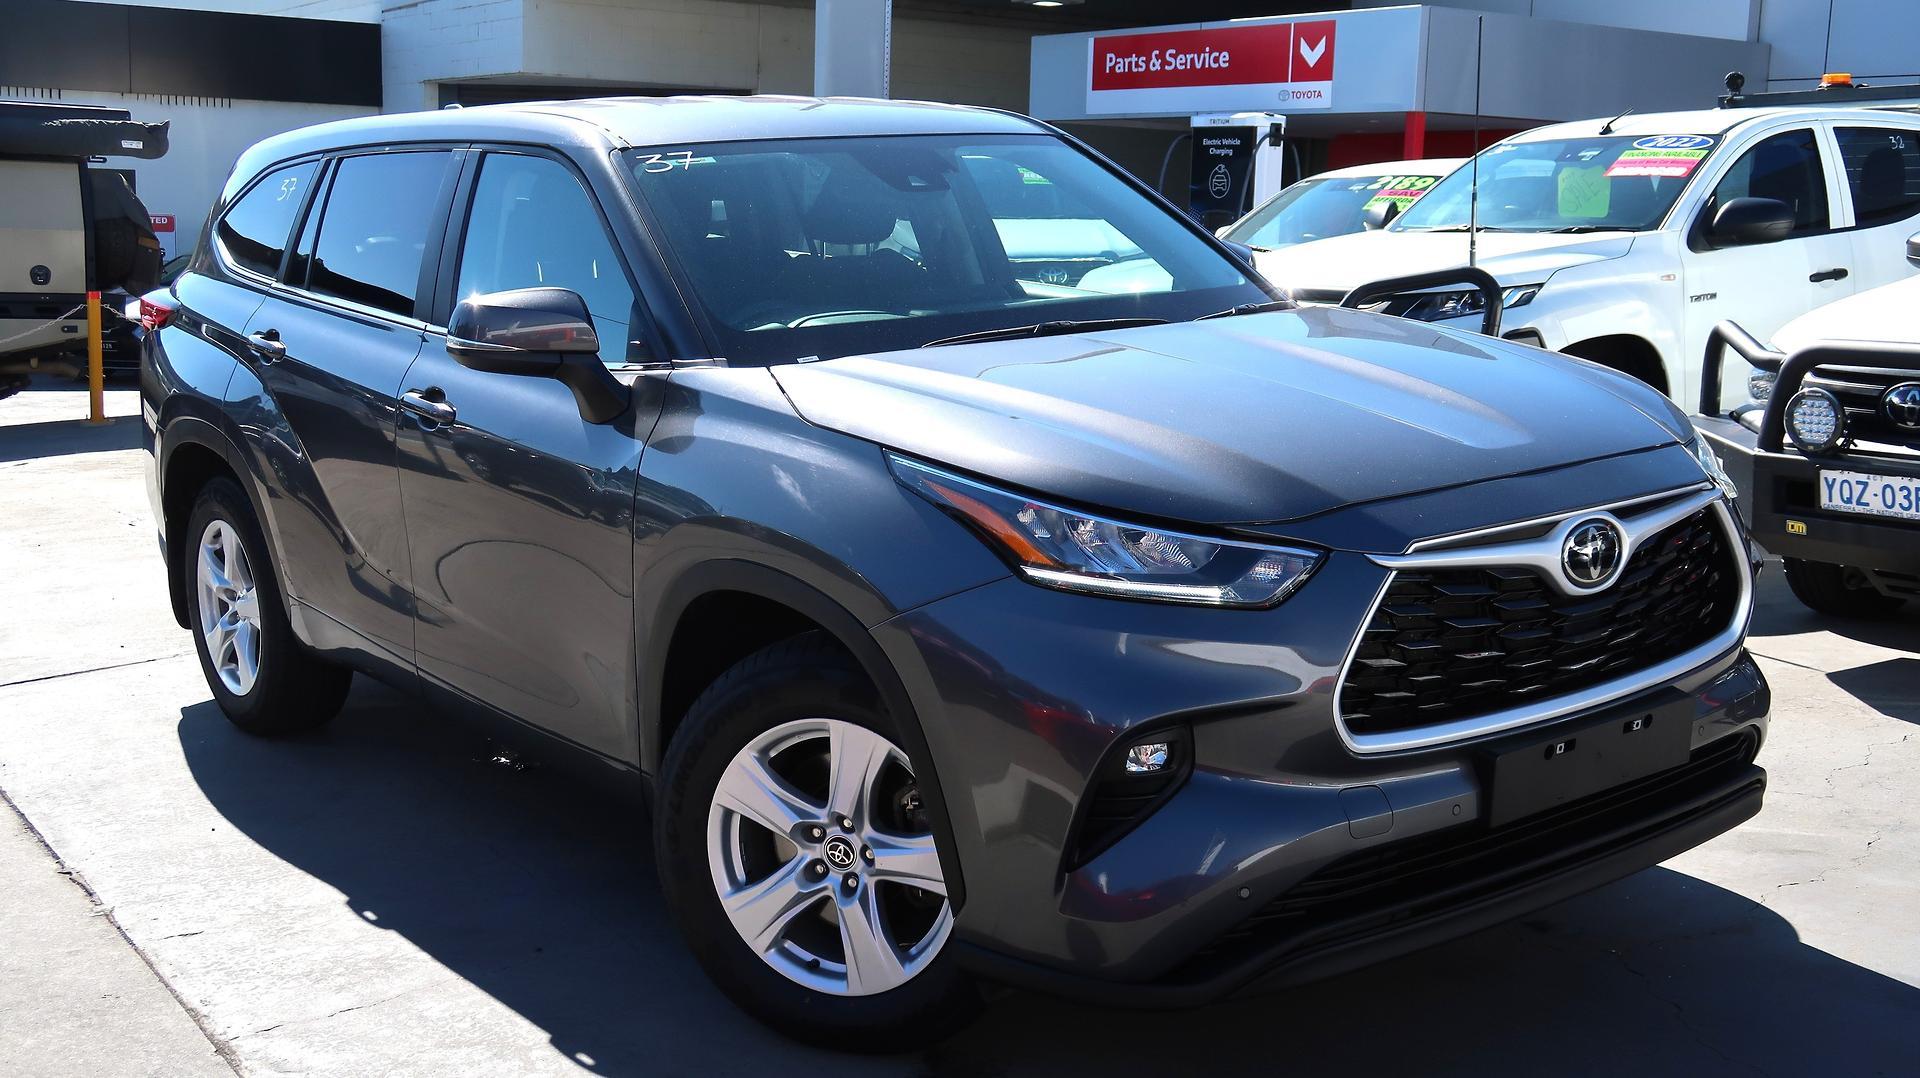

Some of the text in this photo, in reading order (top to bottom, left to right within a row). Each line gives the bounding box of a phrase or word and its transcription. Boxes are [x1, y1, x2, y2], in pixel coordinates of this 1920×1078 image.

[1105, 46, 1230, 74] Parts & Service
[1291, 90, 1322, 100] TOYOTA
[1203, 138, 1241, 146] Electric Vehicle
[1645, 137, 1702, 148] 2022
[1889, 135, 1905, 150] 32
[1209, 147, 1233, 156] Charging
[636, 150, 693, 173] 37
[1366, 175, 1436, 190] 2189
[277, 177, 298, 201] 37
[1689, 292, 1717, 303] TRITON
[1822, 503, 1856, 513] CANBERRA
